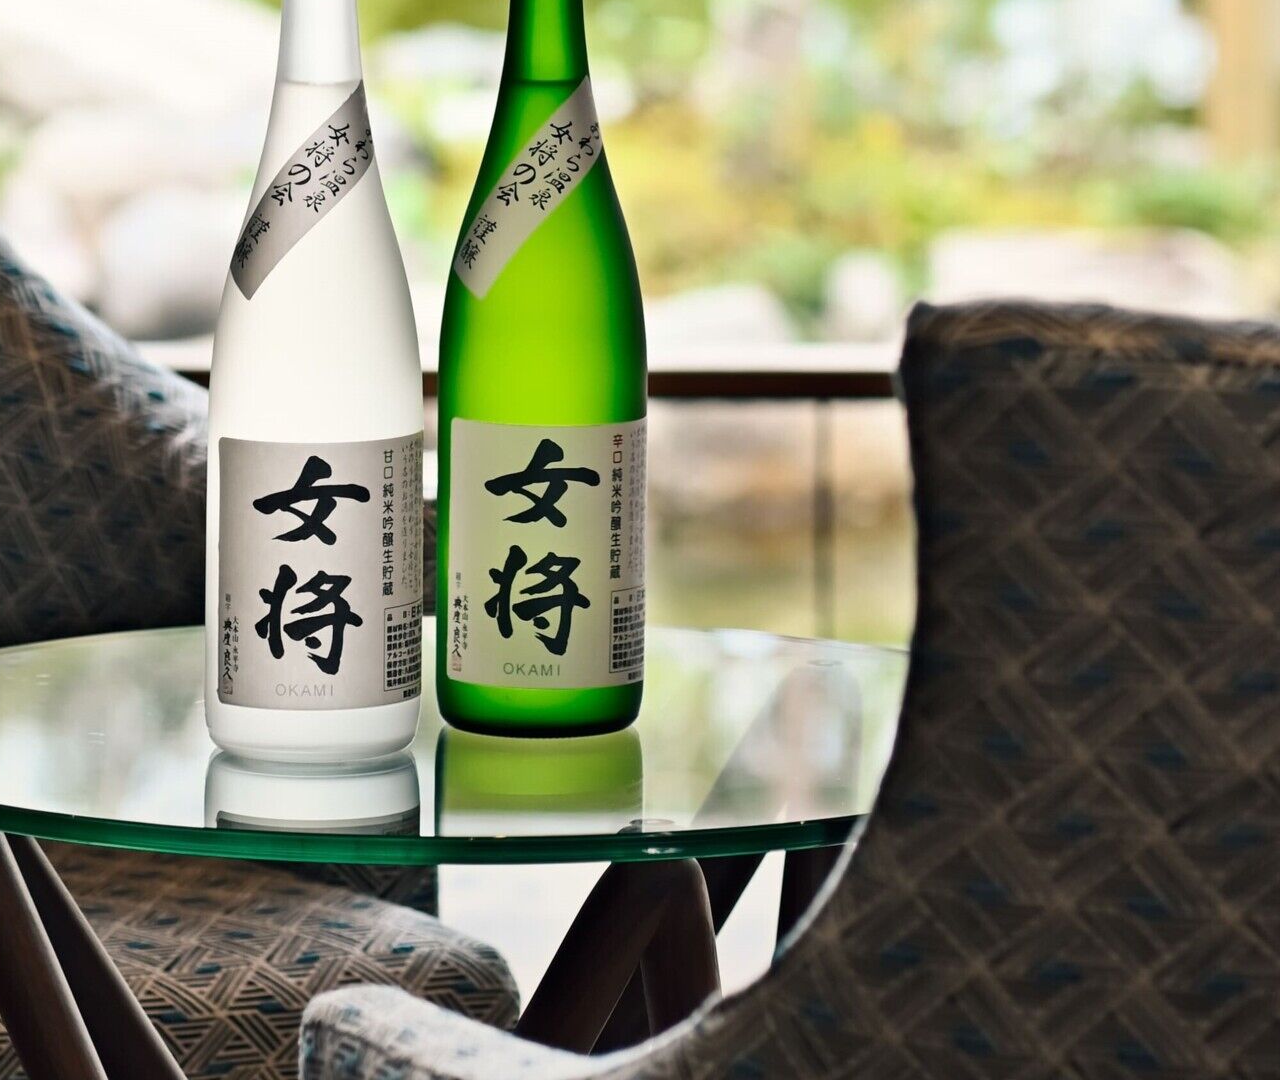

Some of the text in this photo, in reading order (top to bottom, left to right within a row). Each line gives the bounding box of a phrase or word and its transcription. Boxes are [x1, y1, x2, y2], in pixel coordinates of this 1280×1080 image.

[271, 123, 350, 207] 女将の会
[496, 121, 574, 207] 女将の会
[252, 455, 371, 676] 女将
[484, 438, 601, 656] 女将
[275, 682, 334, 697] OKAMI
[502, 662, 561, 677] OKAMI
